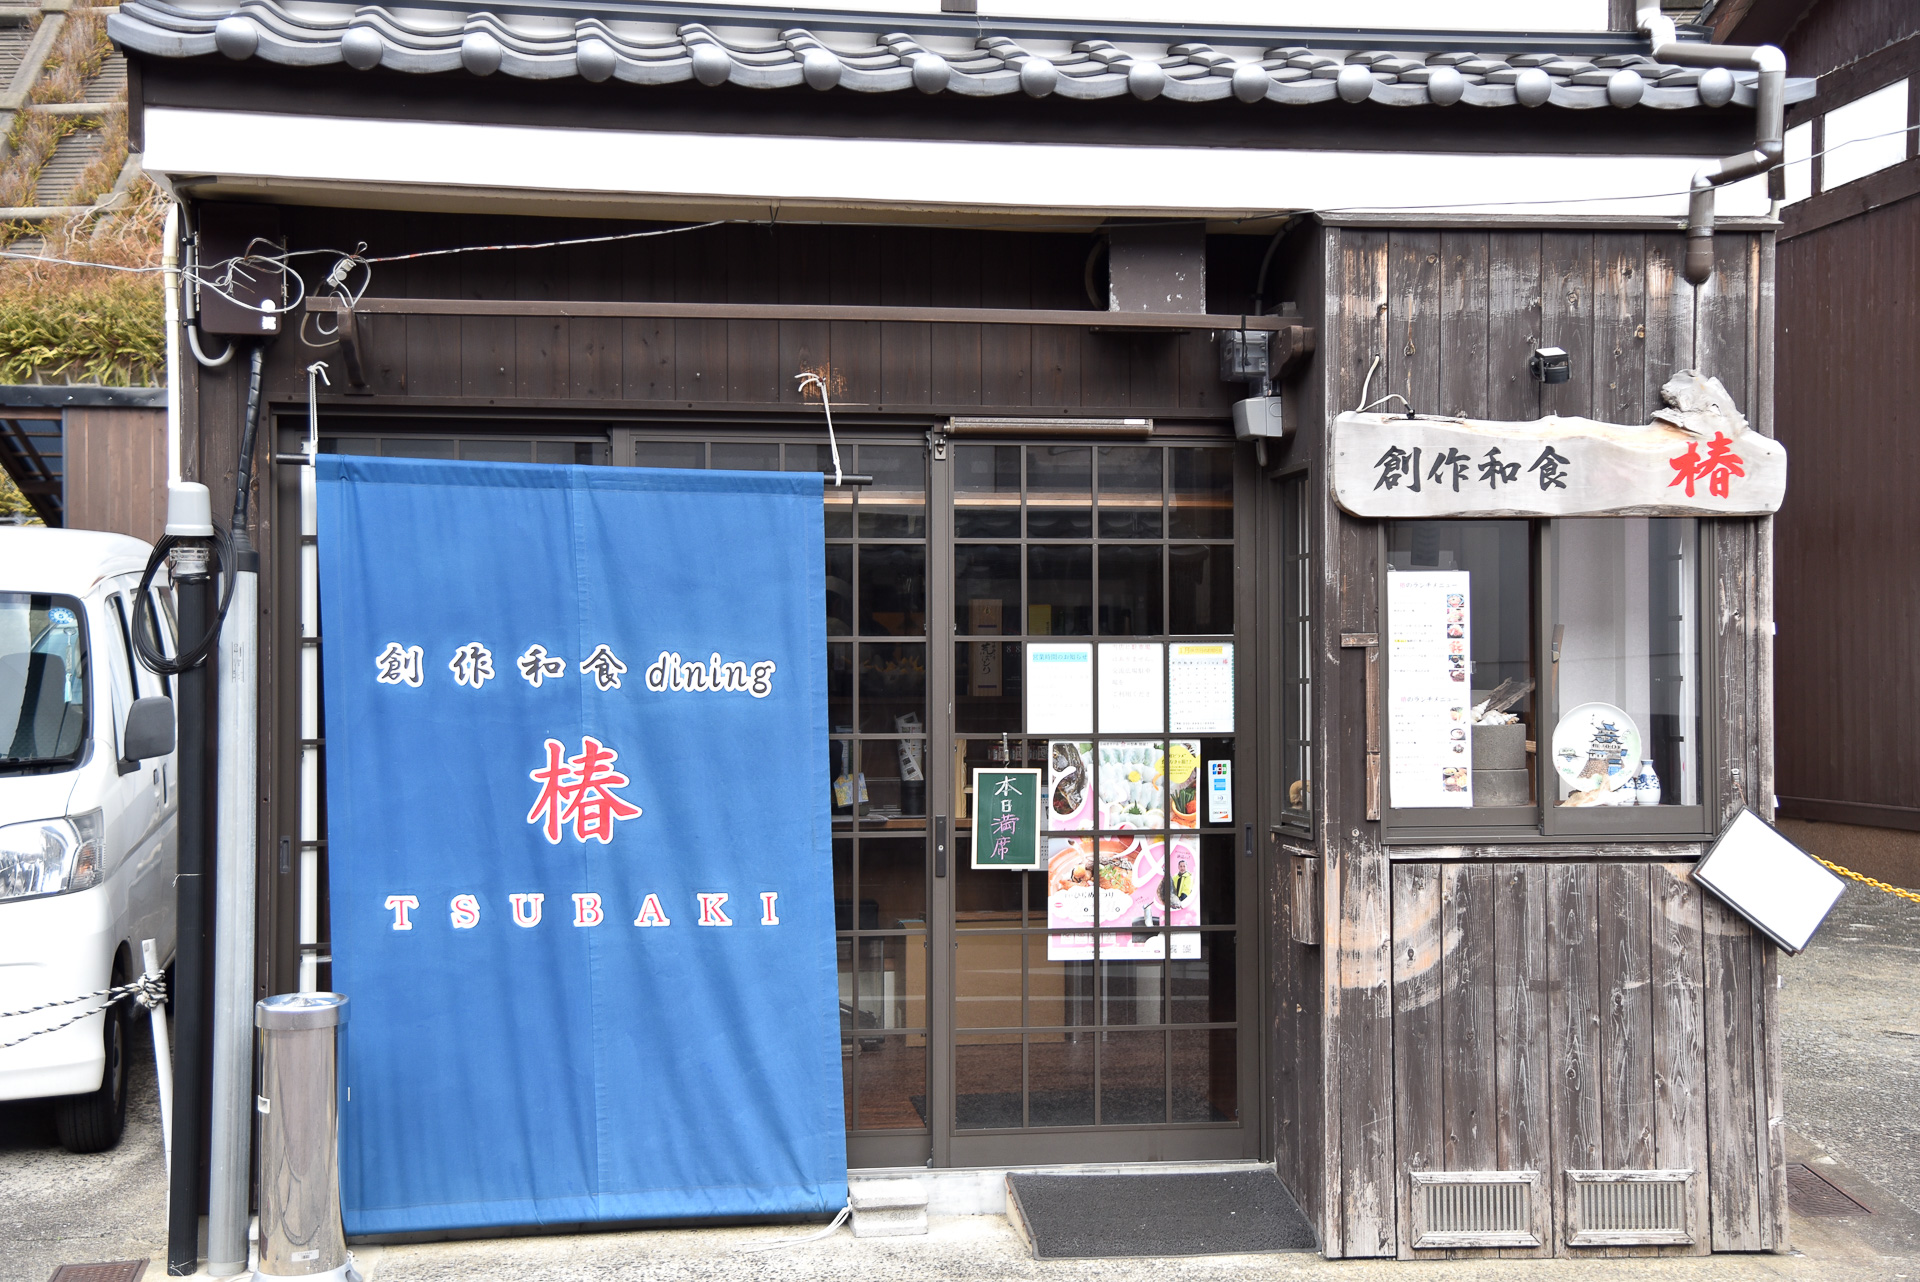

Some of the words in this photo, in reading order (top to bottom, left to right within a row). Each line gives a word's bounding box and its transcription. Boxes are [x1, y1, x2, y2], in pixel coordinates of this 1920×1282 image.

[1373, 445, 1571, 492] 創作和食
[1668, 431, 1746, 499] 椿
[376, 643, 627, 690] 創作和食
[646, 651, 776, 697] dining
[527, 737, 642, 843] 椿
[990, 775, 1023, 861] 本日満席
[385, 892, 779, 931] TSUBAKI
